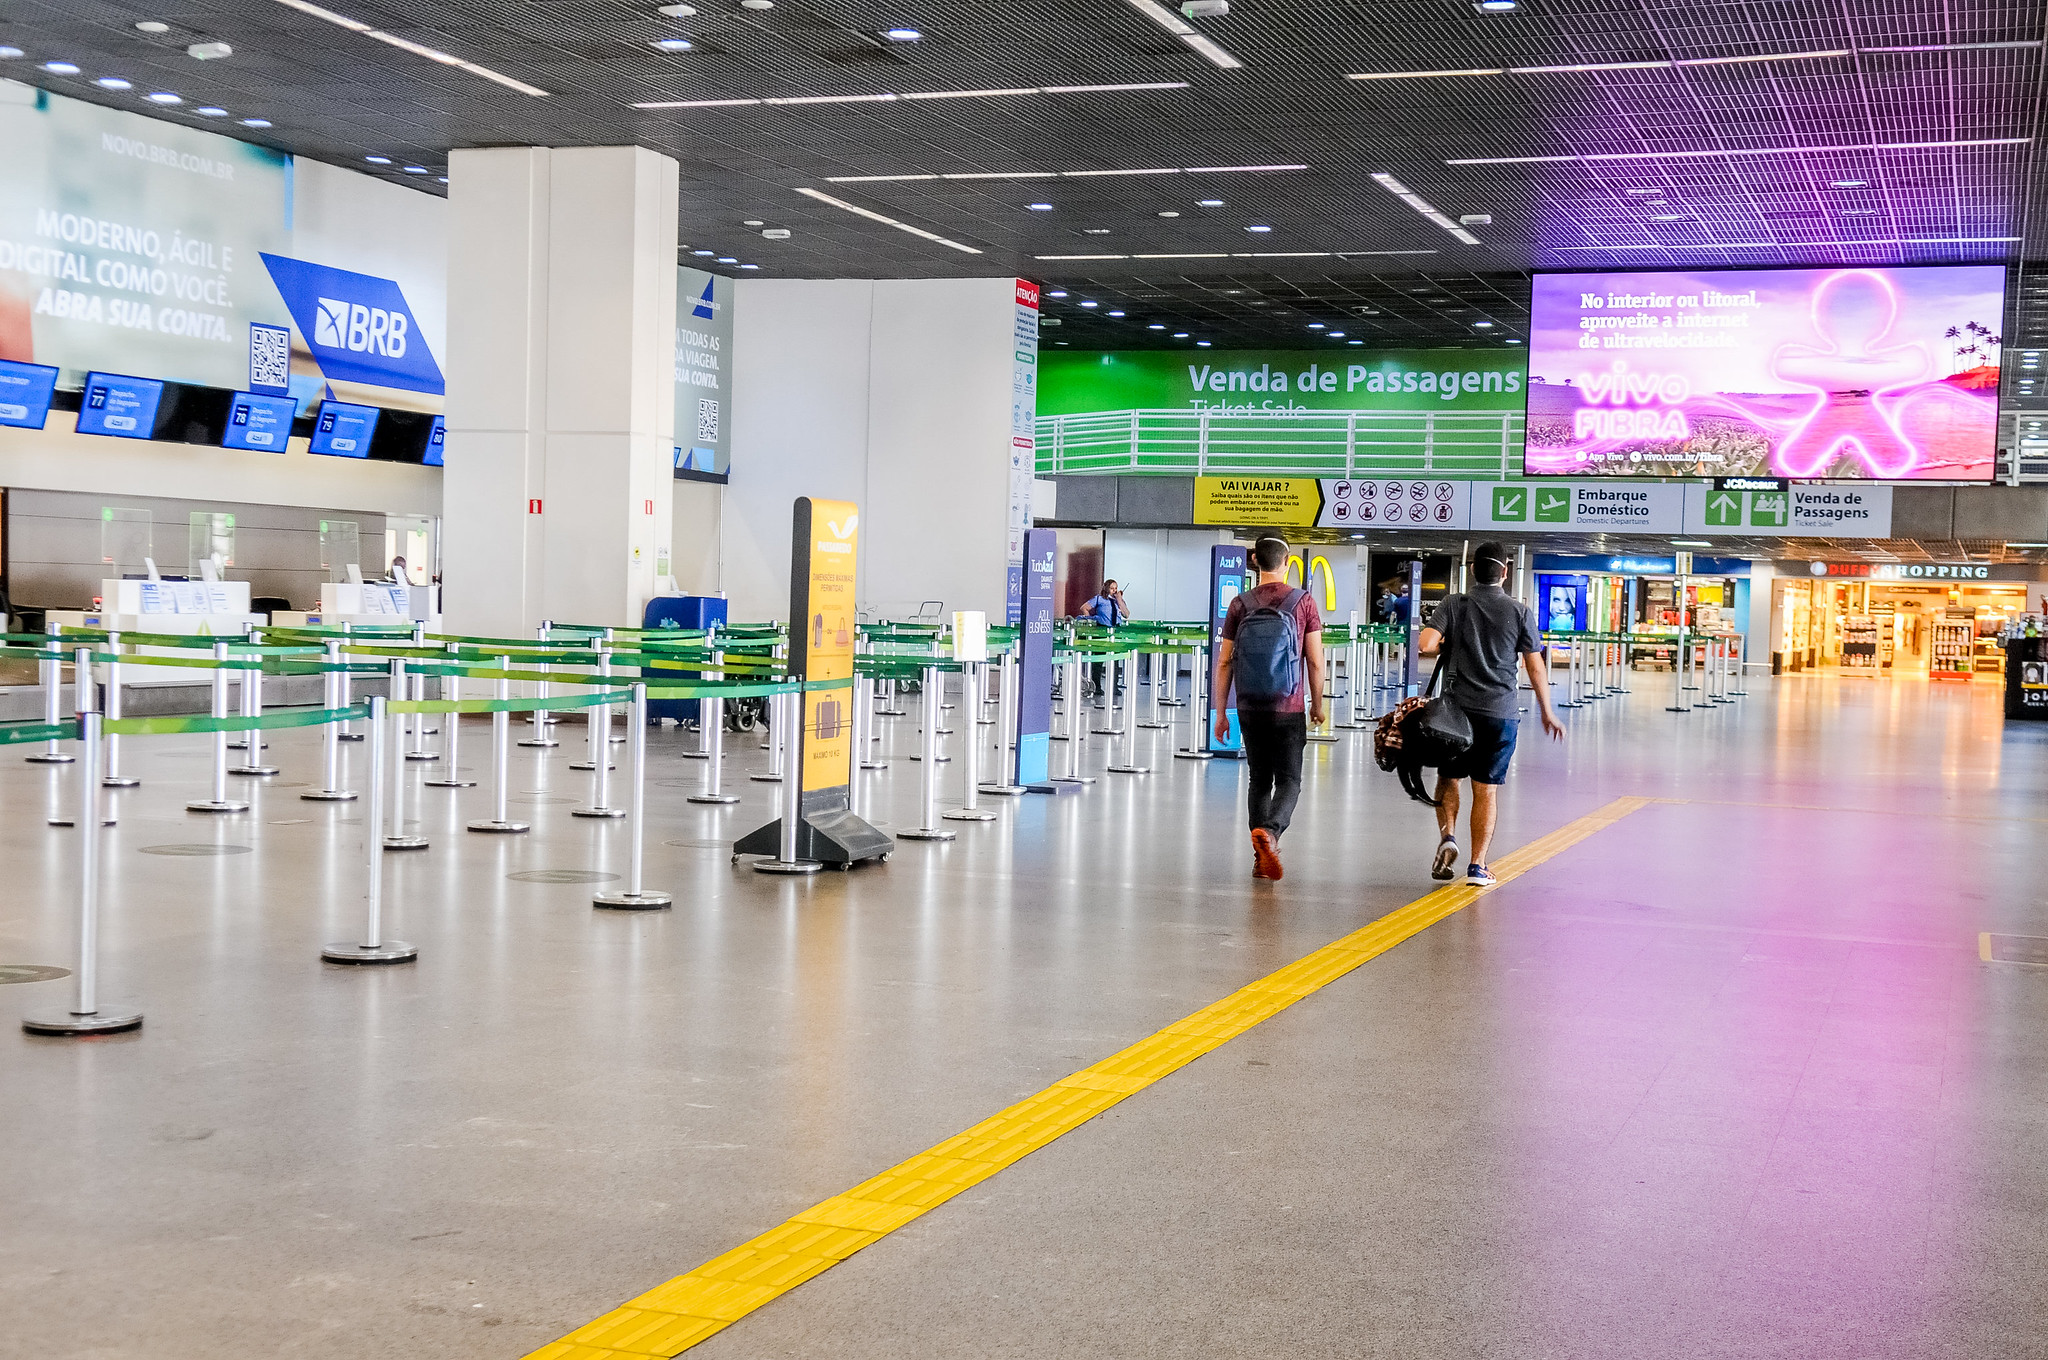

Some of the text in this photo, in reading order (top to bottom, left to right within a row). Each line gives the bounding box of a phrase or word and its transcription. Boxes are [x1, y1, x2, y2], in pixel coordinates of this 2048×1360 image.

[101, 132, 234, 181] NOVO.BRB.COM.BR
[36, 208, 233, 272] MODERNO, ÁGIL E
[0, 240, 233, 308] DIGITAL COMO VOCÊ.
[1017, 287, 1037, 303] ATENÇÃO
[1580, 291, 1762, 309] No interior ou litoral,
[35, 287, 233, 342] ABRA SUA CONTA.
[1579, 312, 1749, 332] aproveite a internet
[348, 303, 408, 359] BRB
[681, 329, 708, 349] TODAS
[709, 336, 720, 351] AS
[1579, 332, 1739, 349] de ultravelocidade.
[685, 349, 720, 370] VIAGEM.
[691, 371, 719, 390] CONTA.
[1188, 363, 1521, 400] Venda de Passagens
[1578, 361, 1690, 405] vivo
[91, 394, 105, 407] 77
[235, 412, 246, 424] 78
[1575, 409, 1691, 440] FIBRA
[323, 420, 333, 431] 79
[433, 433, 443, 444] 80
[1589, 452, 1624, 462] App Vivo
[1221, 481, 1290, 491] VAI VIAJAR ?
[1723, 479, 1778, 490] JCDecaux
[1578, 489, 1648, 503] Embarque
[1795, 492, 1862, 504] Venda de
[1577, 503, 1649, 515] Doméstico
[1794, 506, 1869, 520] Passagens
[1610, 517, 1650, 526] Departures
[1795, 519, 1816, 527] Ticket
[1219, 556, 1235, 568] Azul
[1828, 564, 1988, 578] DUFRY SHOPPING
[1038, 609, 1051, 621] AZUL
[1029, 622, 1051, 634] BUSINESS
